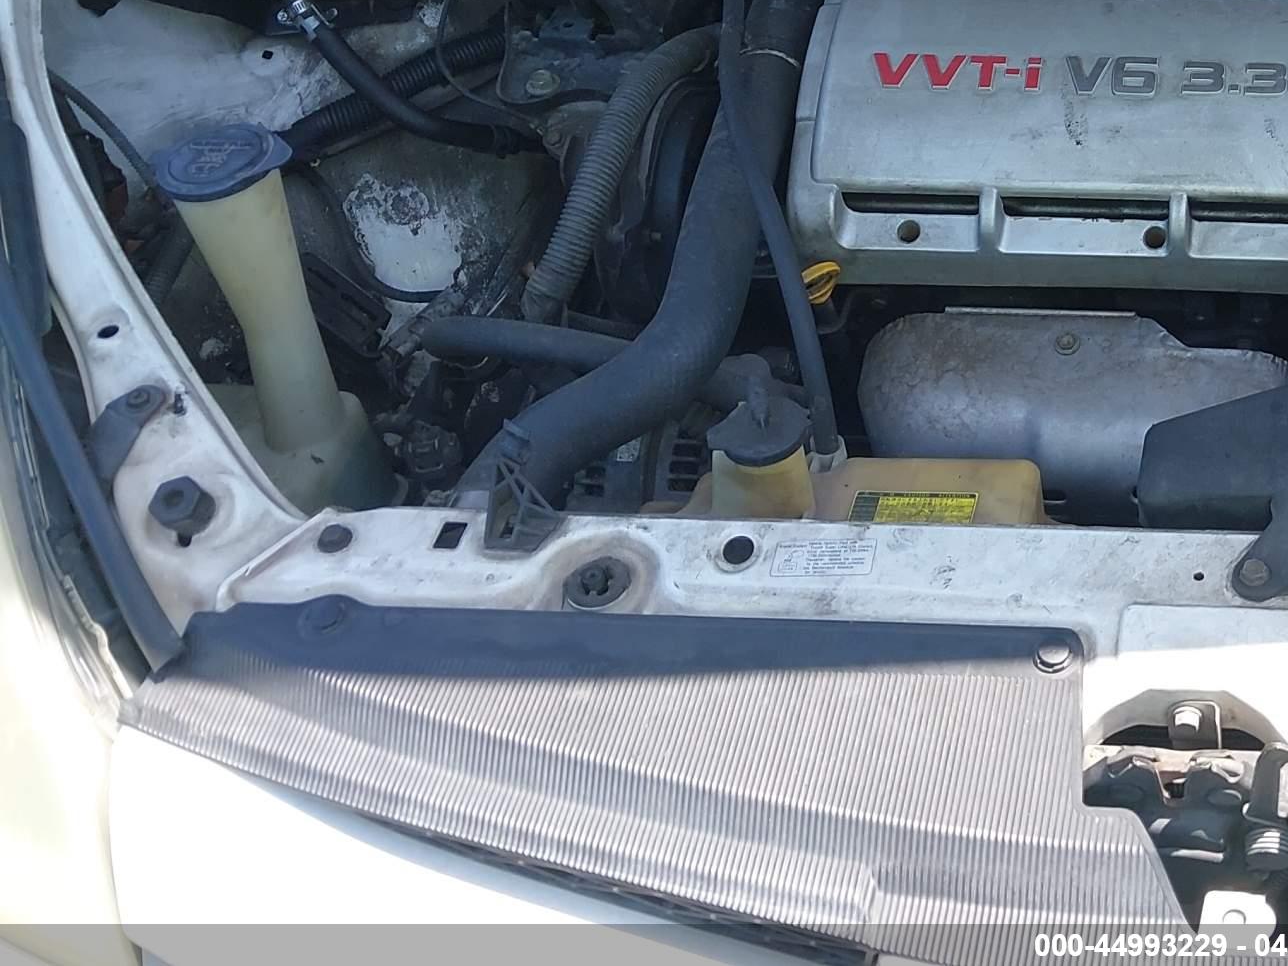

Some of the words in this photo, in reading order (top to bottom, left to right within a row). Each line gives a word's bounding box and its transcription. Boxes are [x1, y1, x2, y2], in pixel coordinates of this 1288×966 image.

[873, 52, 1045, 91] VVT-i
[1066, 55, 1160, 96] V6
[1181, 60, 1288, 97] 3.3
